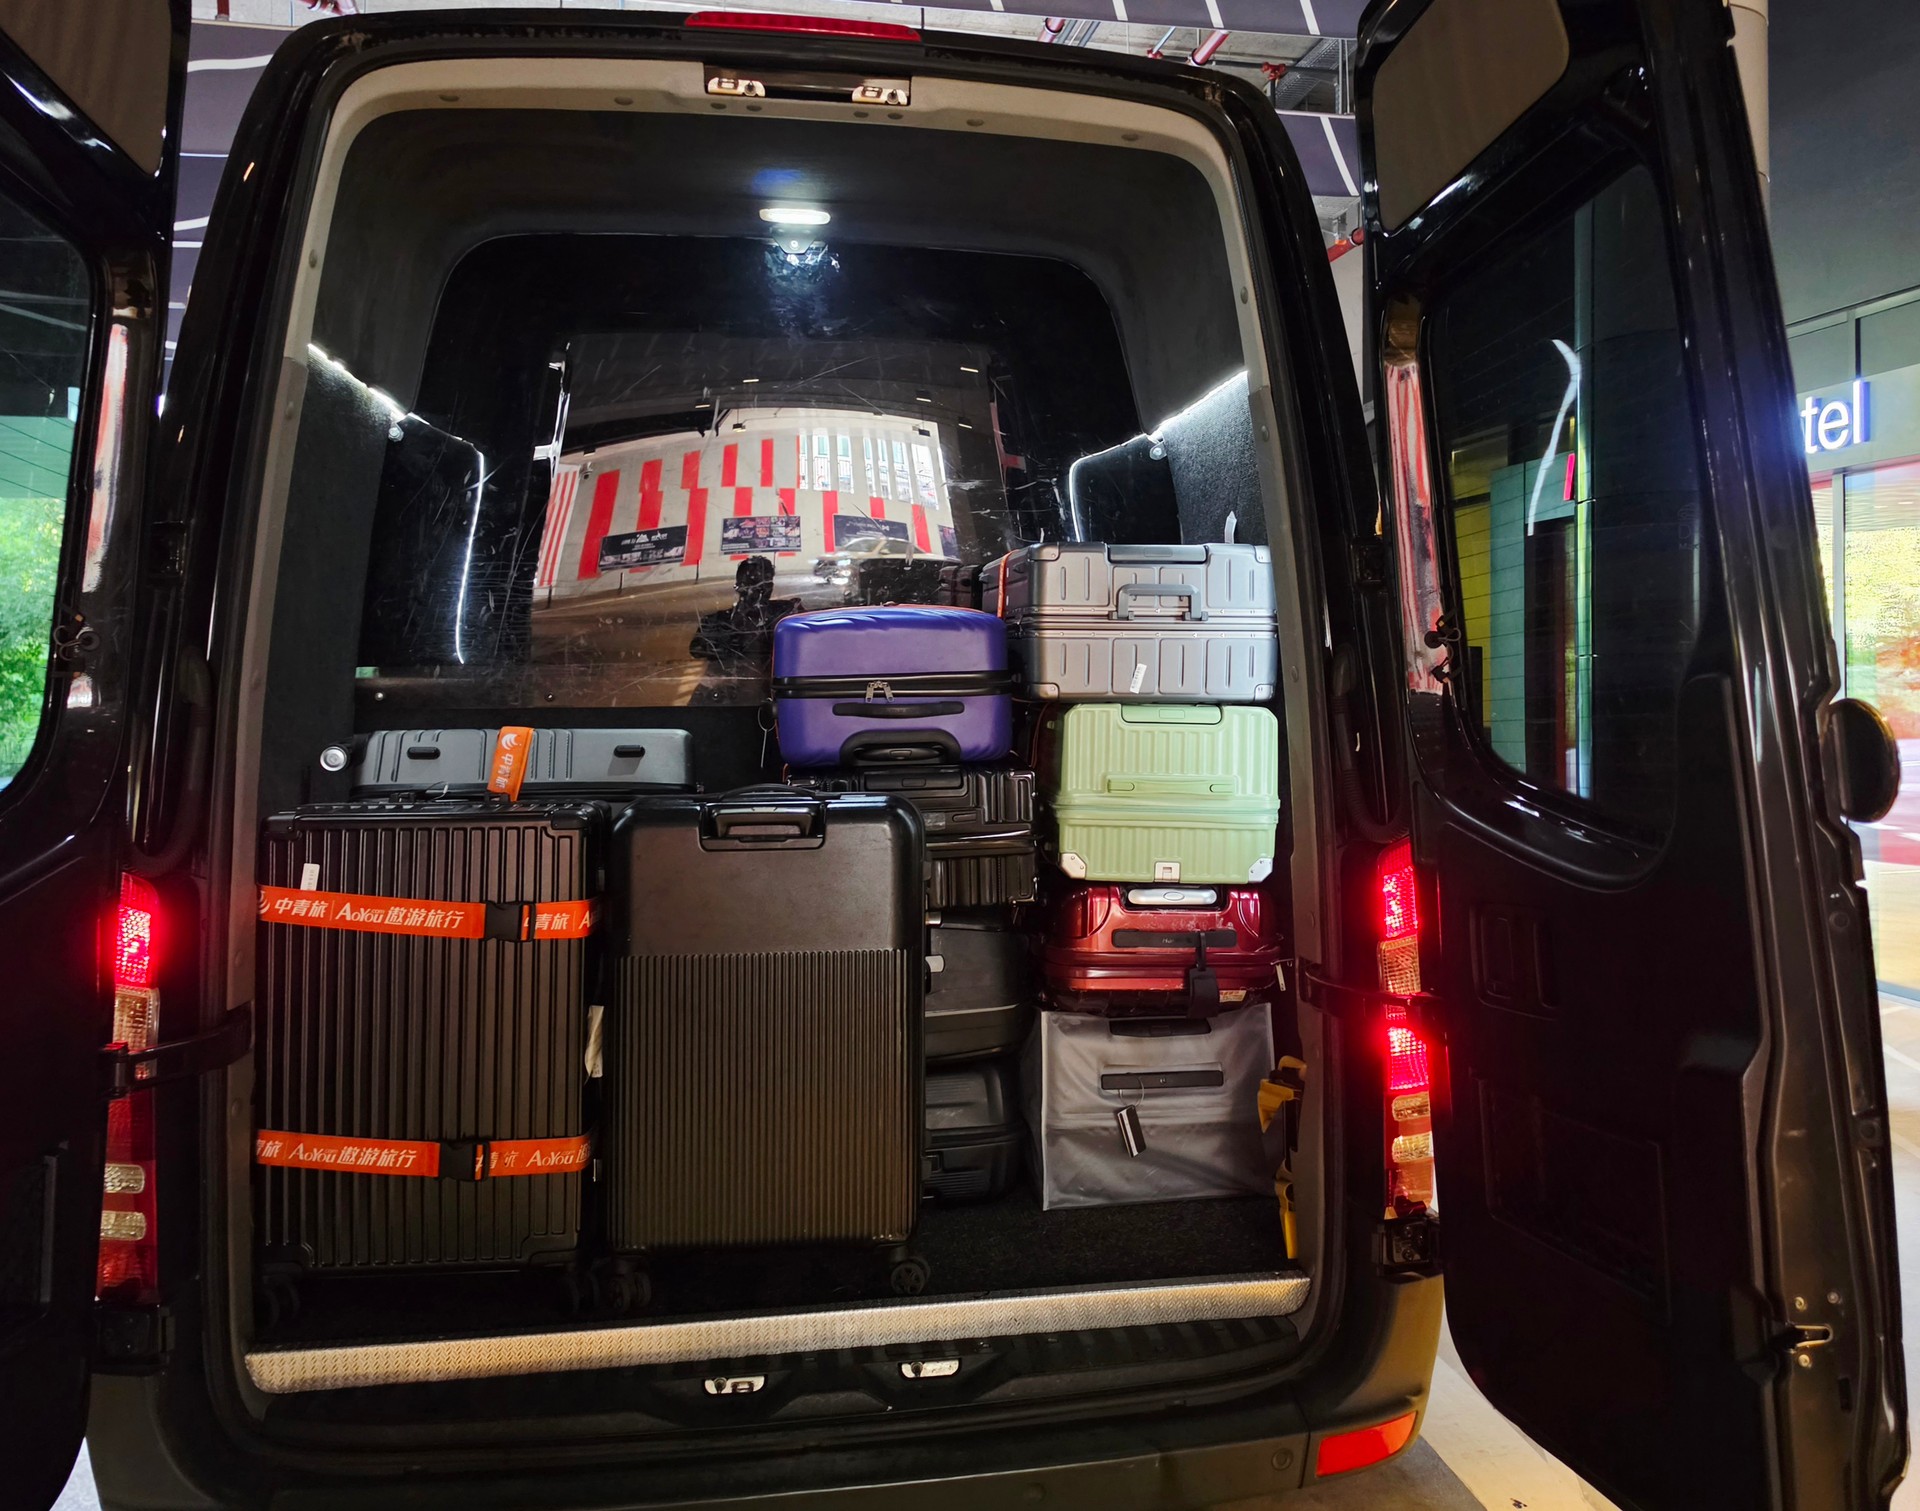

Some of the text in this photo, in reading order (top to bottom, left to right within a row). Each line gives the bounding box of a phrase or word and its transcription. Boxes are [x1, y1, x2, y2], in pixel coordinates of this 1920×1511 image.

[274, 897, 330, 919] 中青旅
[335, 902, 384, 924] AoYou
[384, 905, 466, 929] 遨游旅行
[337, 1145, 418, 1168] 遨游旅行
